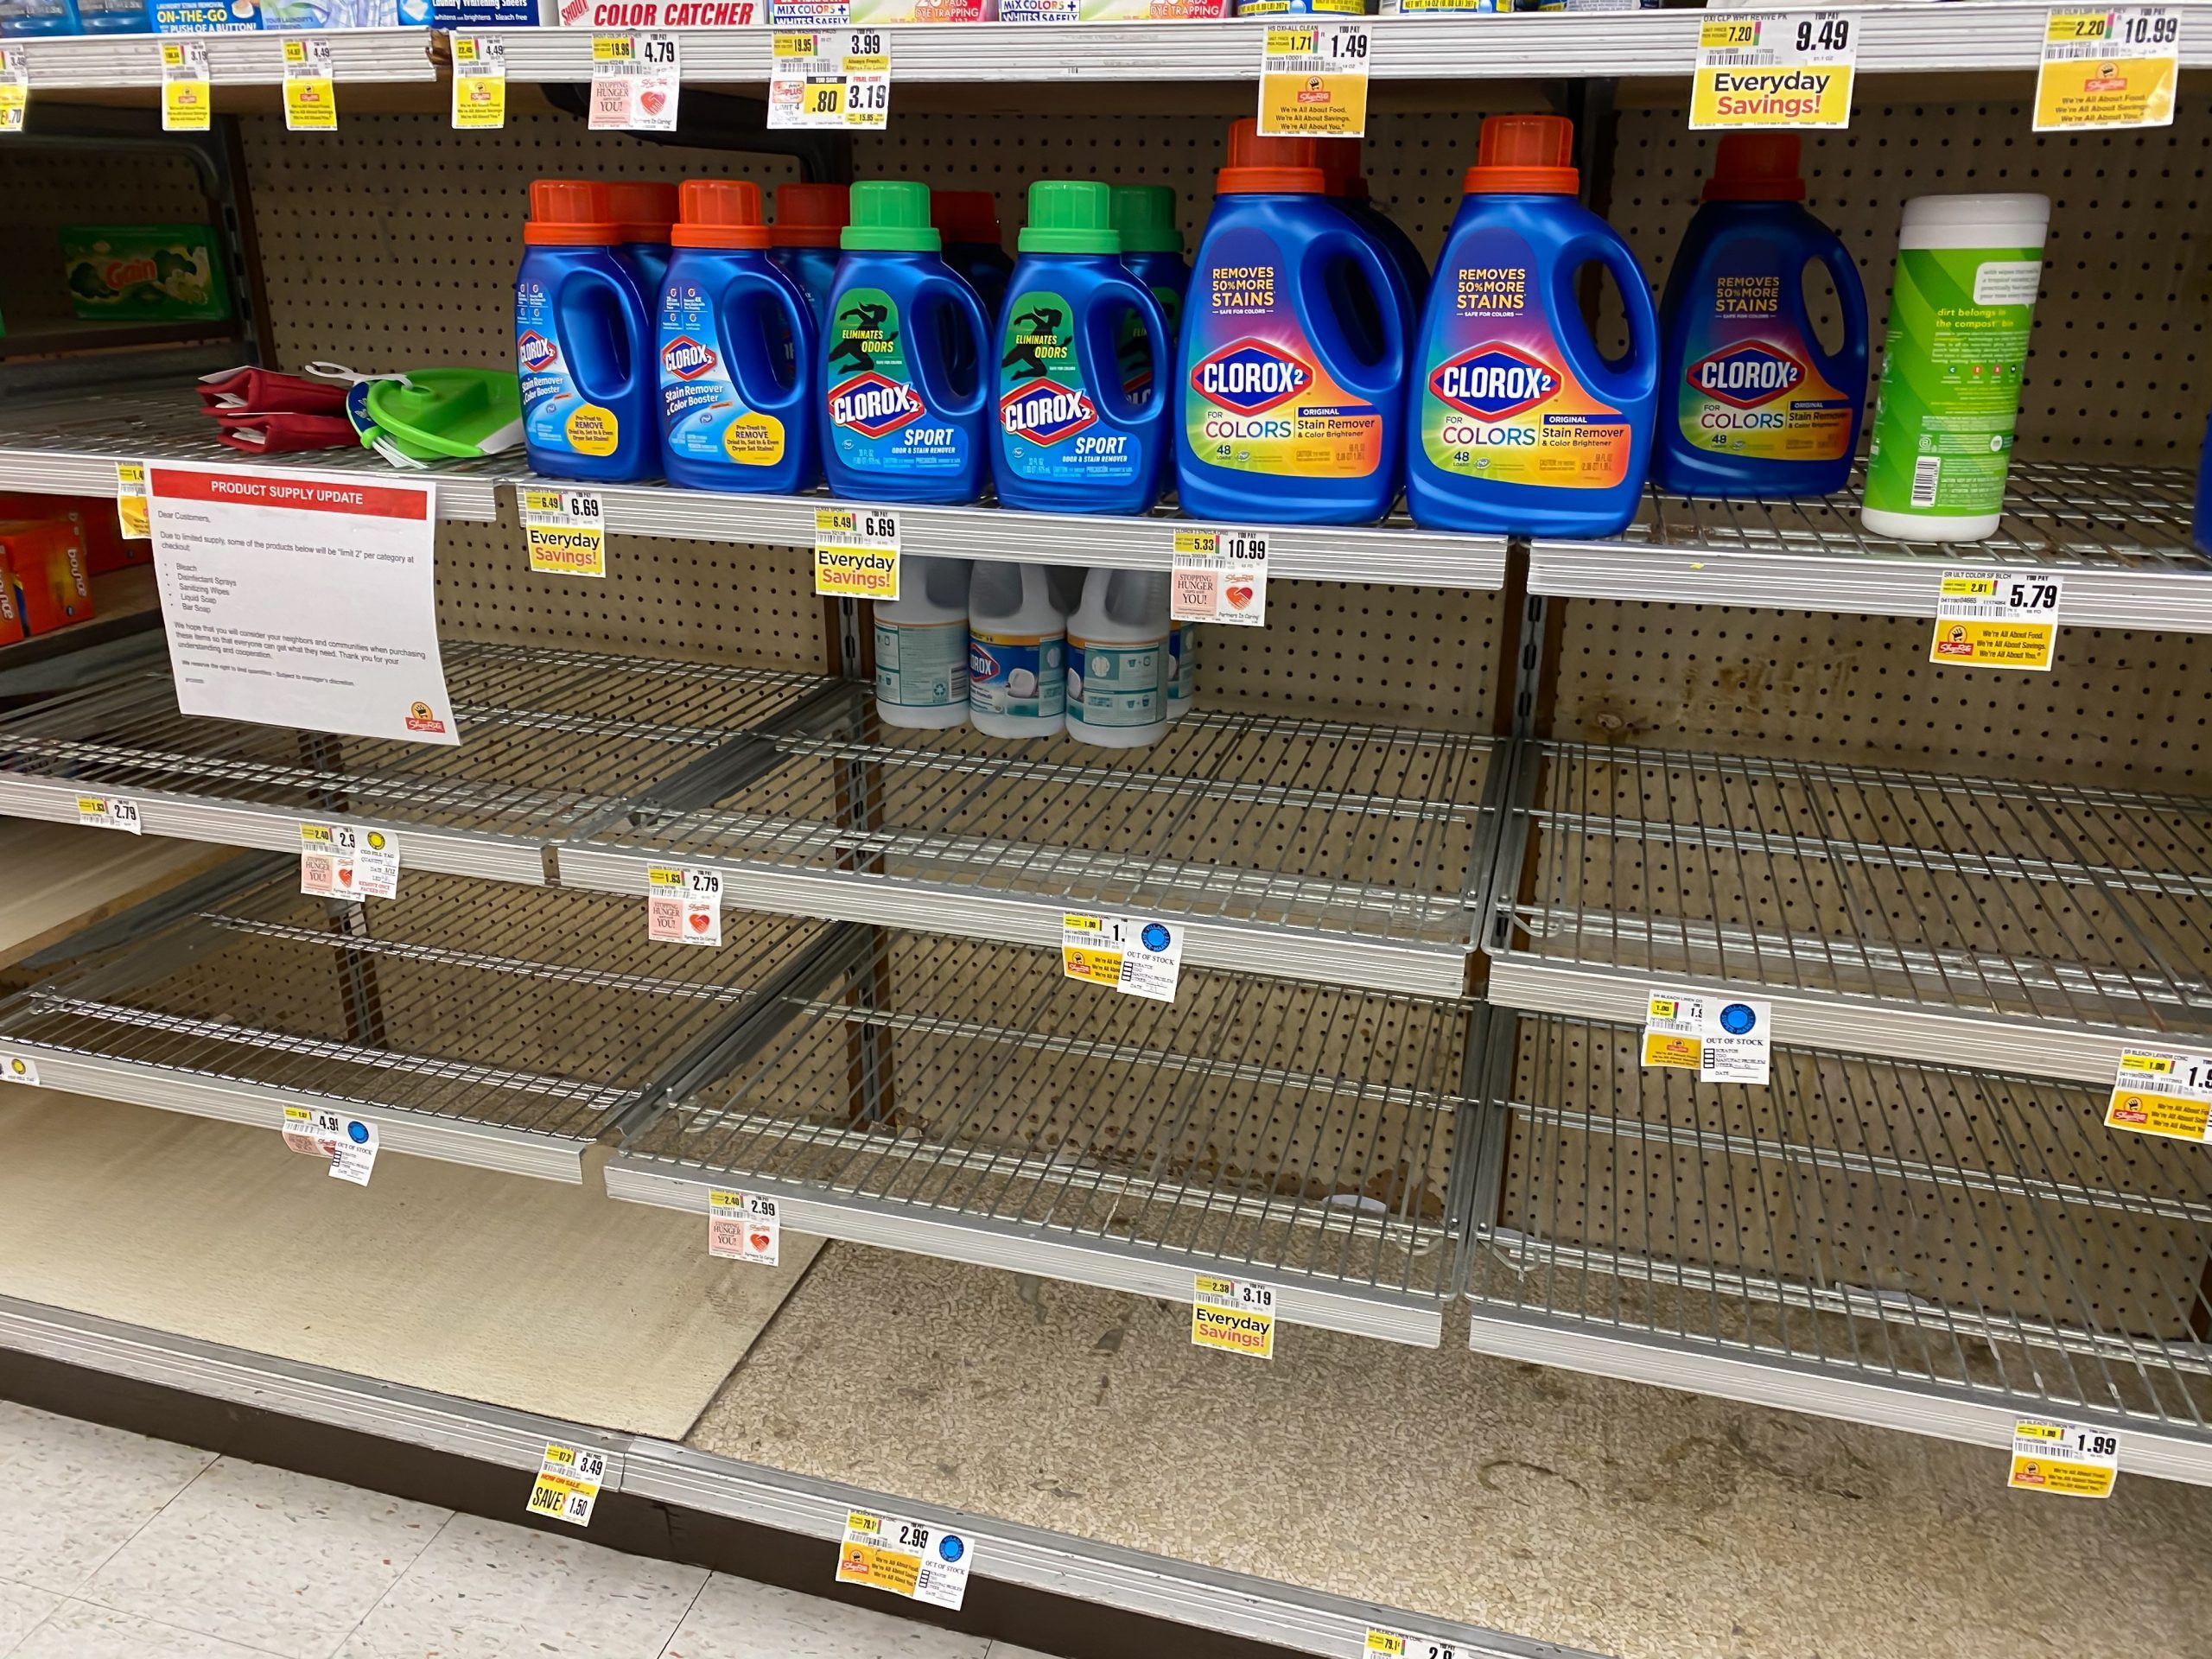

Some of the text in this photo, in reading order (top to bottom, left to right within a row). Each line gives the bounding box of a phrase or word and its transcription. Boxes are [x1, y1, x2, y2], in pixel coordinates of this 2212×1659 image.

[157, 10, 226, 22] ON-THE-GO
[562, 0, 589, 25] SHOUT
[594, 3, 753, 26] COLOR CATCHER
[915, 7, 978, 18] DYE TRAPPING
[1151, 5, 1218, 16] DYE TRAPPING
[1729, 21, 1848, 50] 7.20 9.49
[2075, 18, 2177, 43] 2.20 10.99
[314, 48, 330, 57] 4.49
[612, 42, 674, 62] 19.96 4.79
[794, 35, 880, 54] 19.95 3.99
[1291, 35, 1367, 57] 1.71 1.49
[1714, 71, 1830, 93] Everyday
[596, 88, 628, 97] HUNGER
[812, 86, 886, 111] .80 3.19
[601, 102, 622, 112] YOU!
[1717, 94, 1821, 117] Savings!
[1213, 267, 1274, 278] REMOVES
[1459, 269, 1525, 280] REMOVES
[1213, 280, 1274, 290] 50% MORE
[1212, 292, 1274, 307] STAINS
[1457, 295, 1524, 309] STAINS
[1716, 299, 1777, 312] STAINS
[1958, 308, 1995, 318] belongs
[842, 330, 883, 340] ELIMINATES
[1016, 335, 1057, 345] ELIMINATES
[861, 341, 893, 353] ODORS
[1035, 346, 1067, 358] ODORS
[1205, 421, 1291, 439] COLORS
[1298, 419, 1374, 429] Stain Remover
[1542, 428, 1623, 438] Stain Remover
[905, 429, 954, 446] SPORT
[1076, 437, 1127, 454] SPORT
[1443, 427, 1535, 446] COLORS
[1712, 435, 1726, 443] 48
[1217, 445, 1230, 454] 48
[1454, 451, 1469, 461] 48
[212, 481, 363, 505] PRODUCT SUPPLY UPDATE
[542, 497, 599, 517] 6.49 6.69
[175, 512, 210, 523] Customers,
[834, 517, 894, 537] 6.49 6.69
[531, 530, 600, 550] Everyday
[1194, 538, 1265, 559] 5.33 10.99
[204, 536, 225, 545] supply,
[266, 542, 293, 551] products
[377, 554, 405, 563] category
[536, 547, 596, 566] Savings!
[819, 550, 894, 572] Everyday
[67, 549, 86, 596] bounce
[823, 569, 890, 588] Savings!
[1178, 581, 1212, 590] HUNGER
[200, 595, 216, 604] Soap
[1183, 594, 1207, 605] YOU!
[2010, 584, 2057, 608] 5.79
[194, 605, 211, 613] Soap
[970, 654, 991, 675] OROX
[115, 804, 137, 820] 2.79
[665, 874, 718, 892] 1.63 2.79
[1152, 955, 1174, 965] STOCK
[725, 1197, 775, 1216] 2.40 2.99
[1212, 1283, 1271, 1306] 2.38 3.19
[1197, 1308, 1269, 1335] Everyday
[1199, 1324, 1264, 1348] Savings!
[2077, 1434, 2116, 1455] 1.99
[581, 1458, 602, 1476] 3.49
[533, 1487, 588, 1516] SAVE 1.50
[899, 1526, 929, 1548] 2.99
